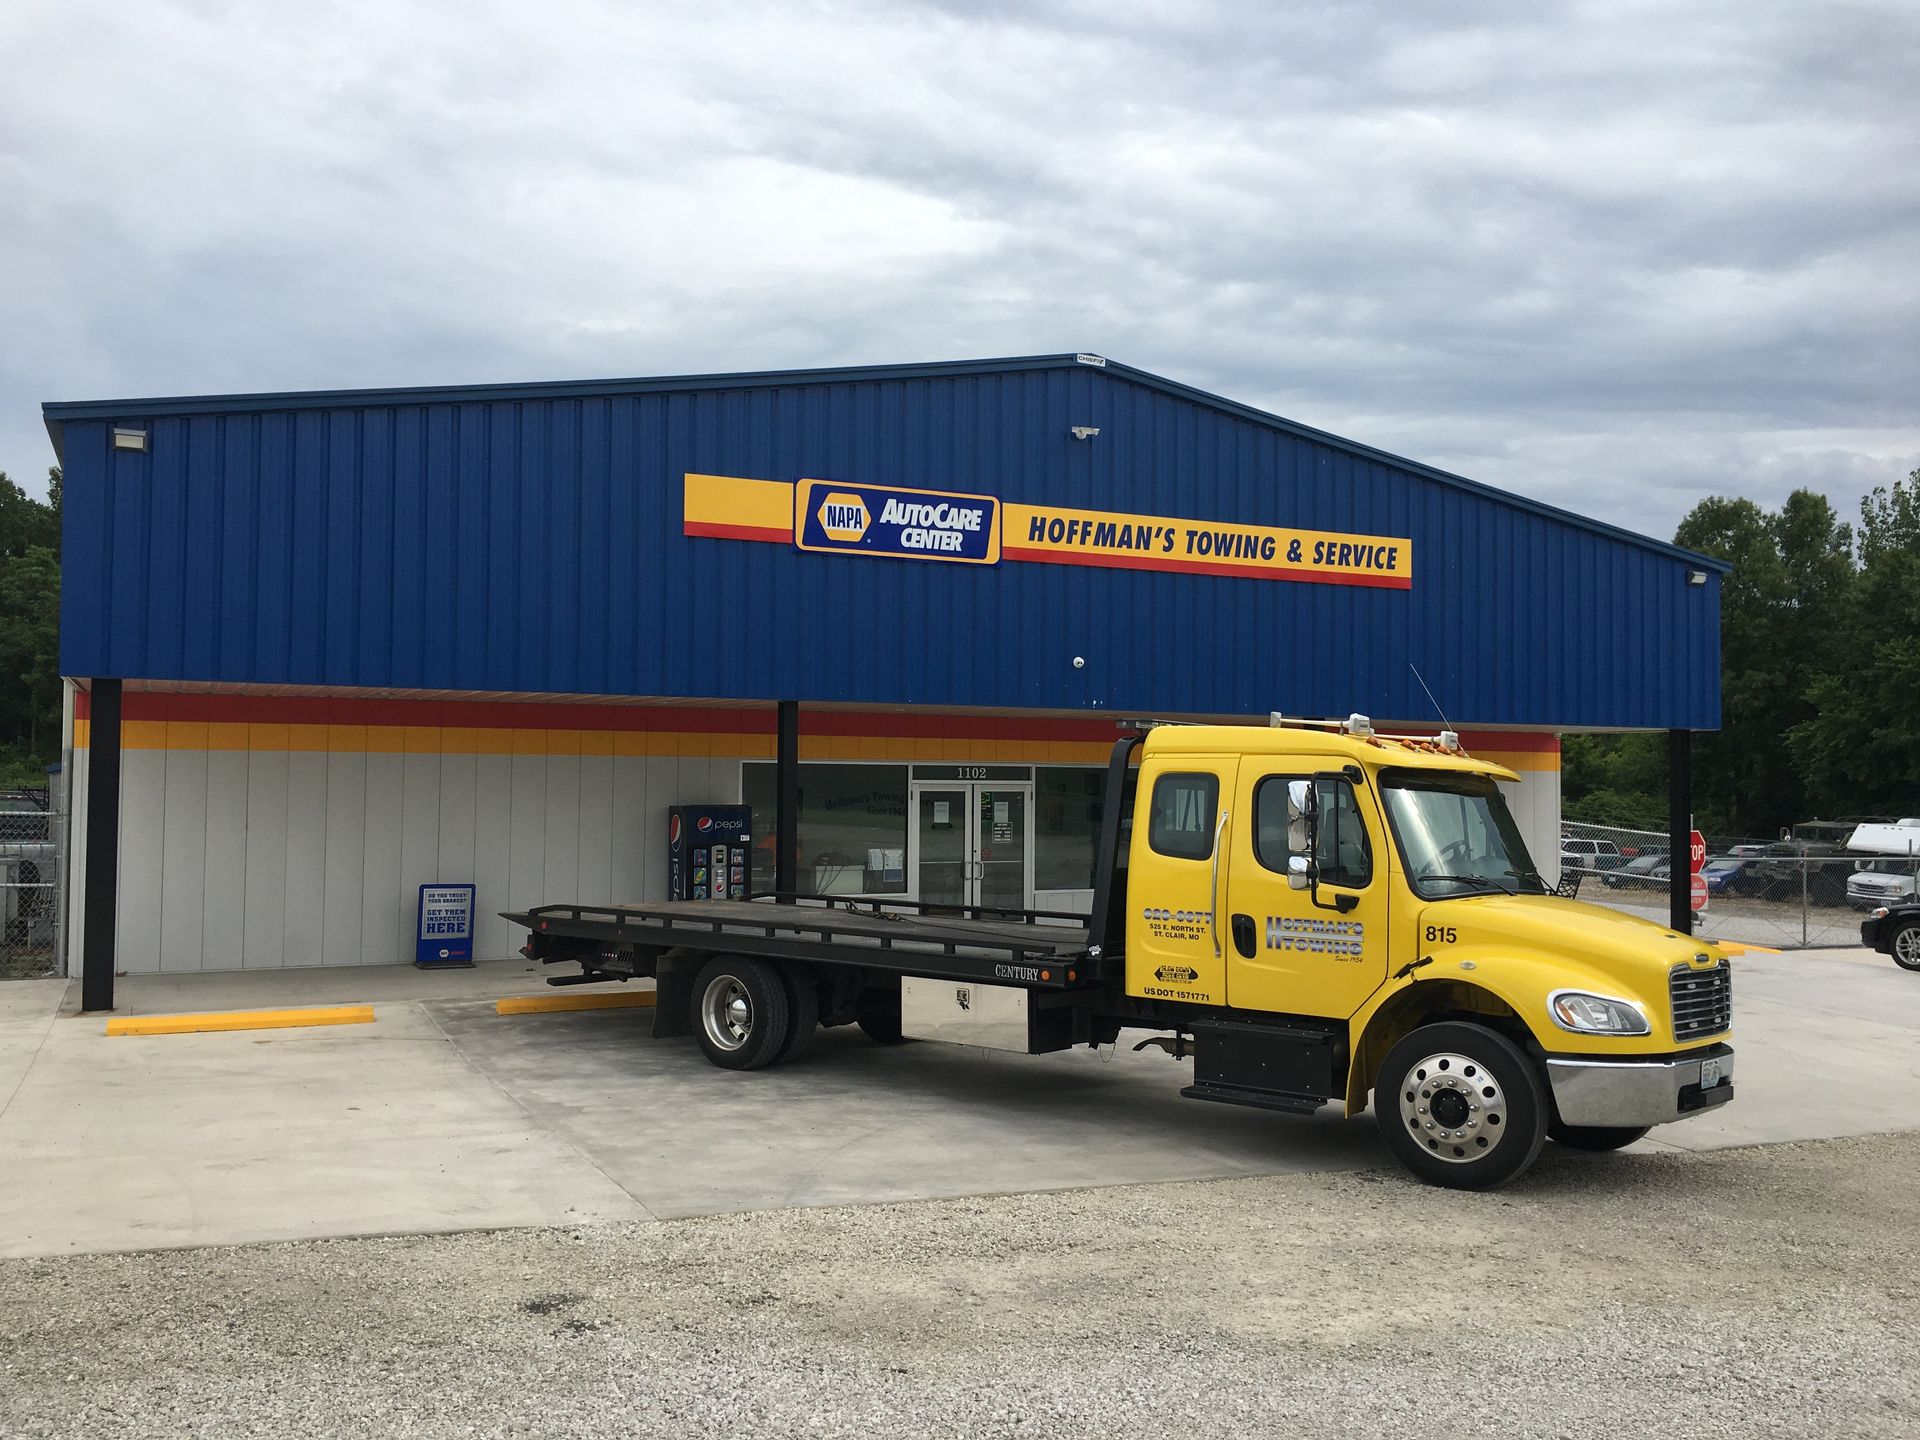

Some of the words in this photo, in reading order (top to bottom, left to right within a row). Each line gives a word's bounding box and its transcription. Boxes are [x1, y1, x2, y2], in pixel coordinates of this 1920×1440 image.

[827, 505, 863, 530] NAPA
[900, 527, 963, 552] CENTER
[1028, 516, 1176, 553] HOFFMAN'S
[1186, 530, 1276, 560] TOWING
[1286, 538, 1303, 563] &
[1312, 543, 1398, 570] SERVICE
[958, 767, 987, 779] 1102
[714, 819, 743, 830] pepsi
[426, 922, 466, 933] HERE
[1170, 925, 1194, 933] NORTH
[1266, 916, 1364, 949] HOFFMAN'S
[1425, 926, 1457, 944] 815
[995, 964, 1039, 981] CENTURY
[1176, 990, 1210, 1001] 1571771
